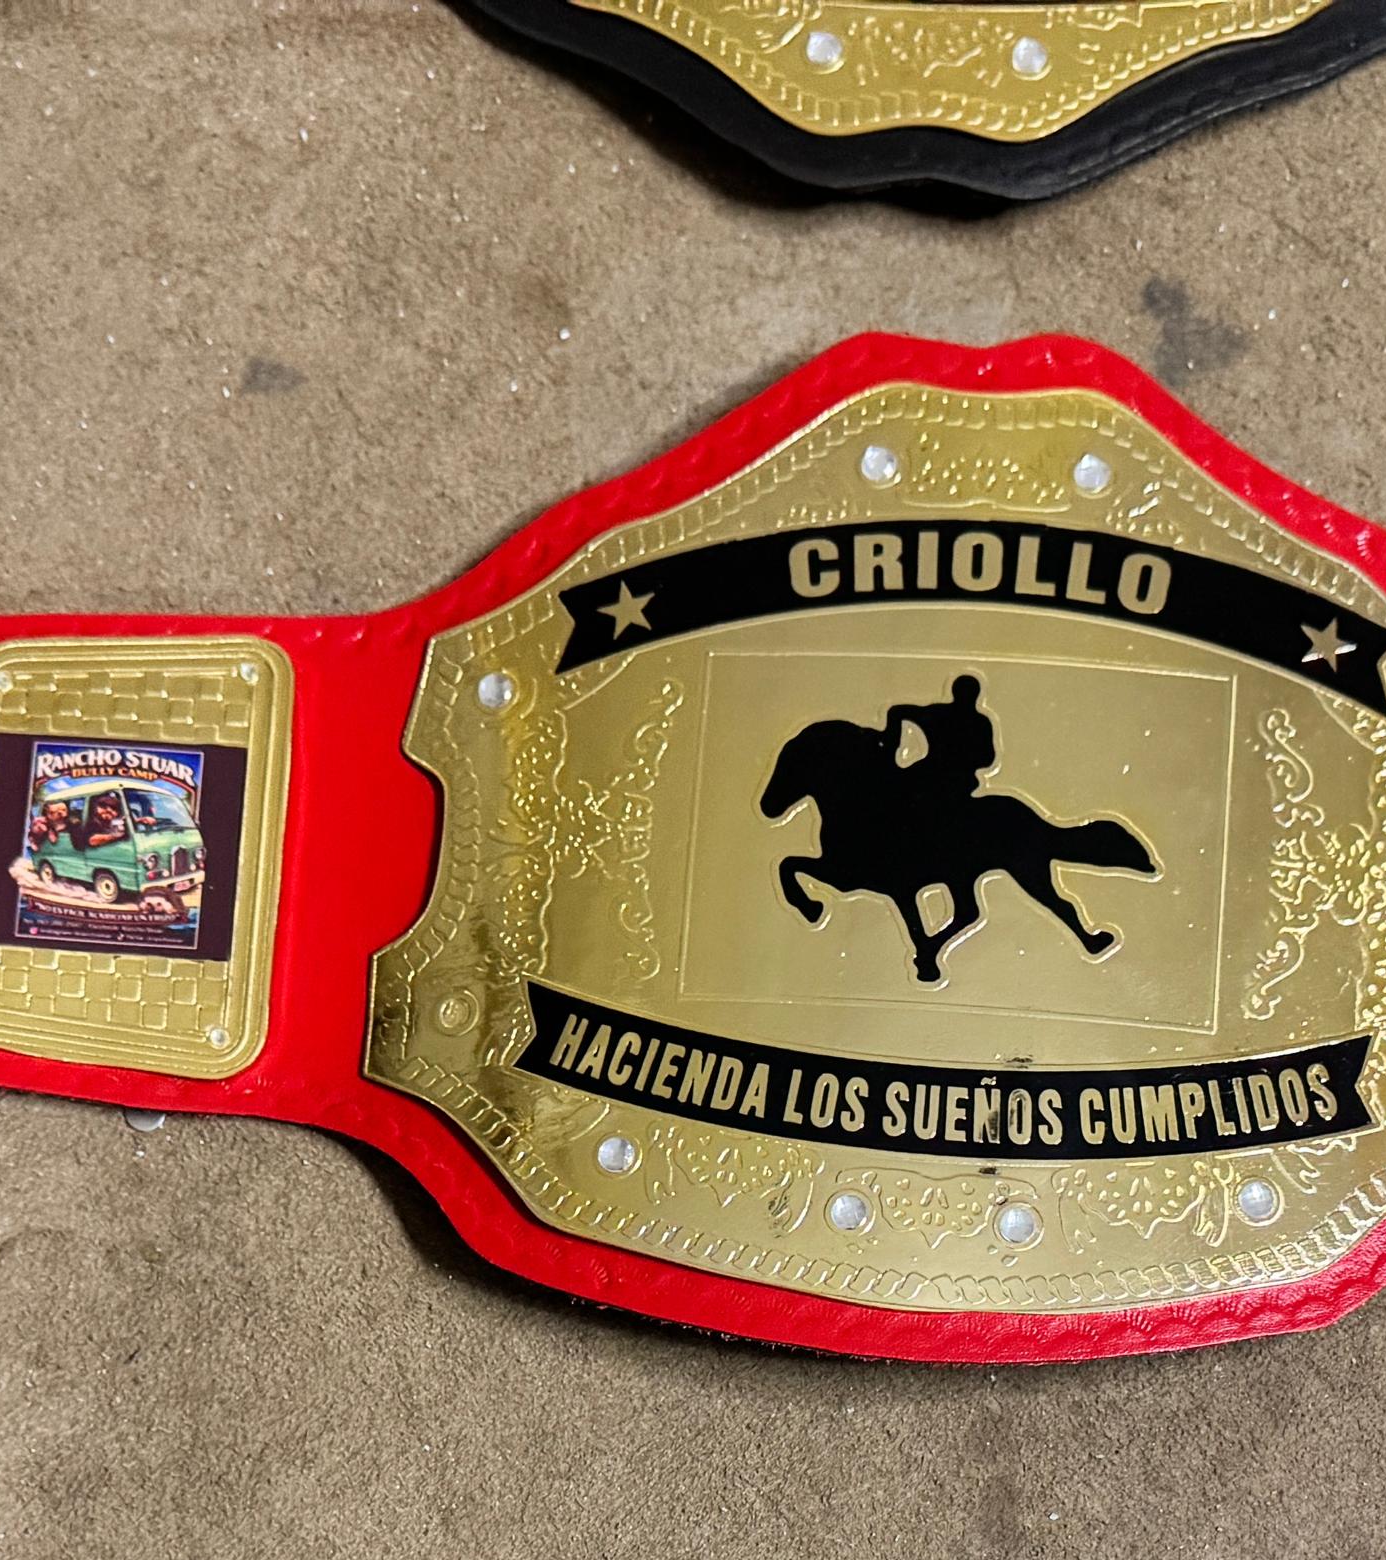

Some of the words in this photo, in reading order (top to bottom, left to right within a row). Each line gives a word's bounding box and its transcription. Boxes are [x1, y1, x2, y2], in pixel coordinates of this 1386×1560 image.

[789, 531, 1172, 614] CRIOLLO
[37, 749, 122, 779] RANCHO
[125, 751, 196, 787] STUAR
[117, 767, 158, 780] CAMP
[549, 1013, 770, 1119] HACIENDA
[783, 1069, 869, 1132] LOS
[882, 1075, 1063, 1145] SUEÑOS
[1079, 1064, 1338, 1145] CUMPLIDOS
